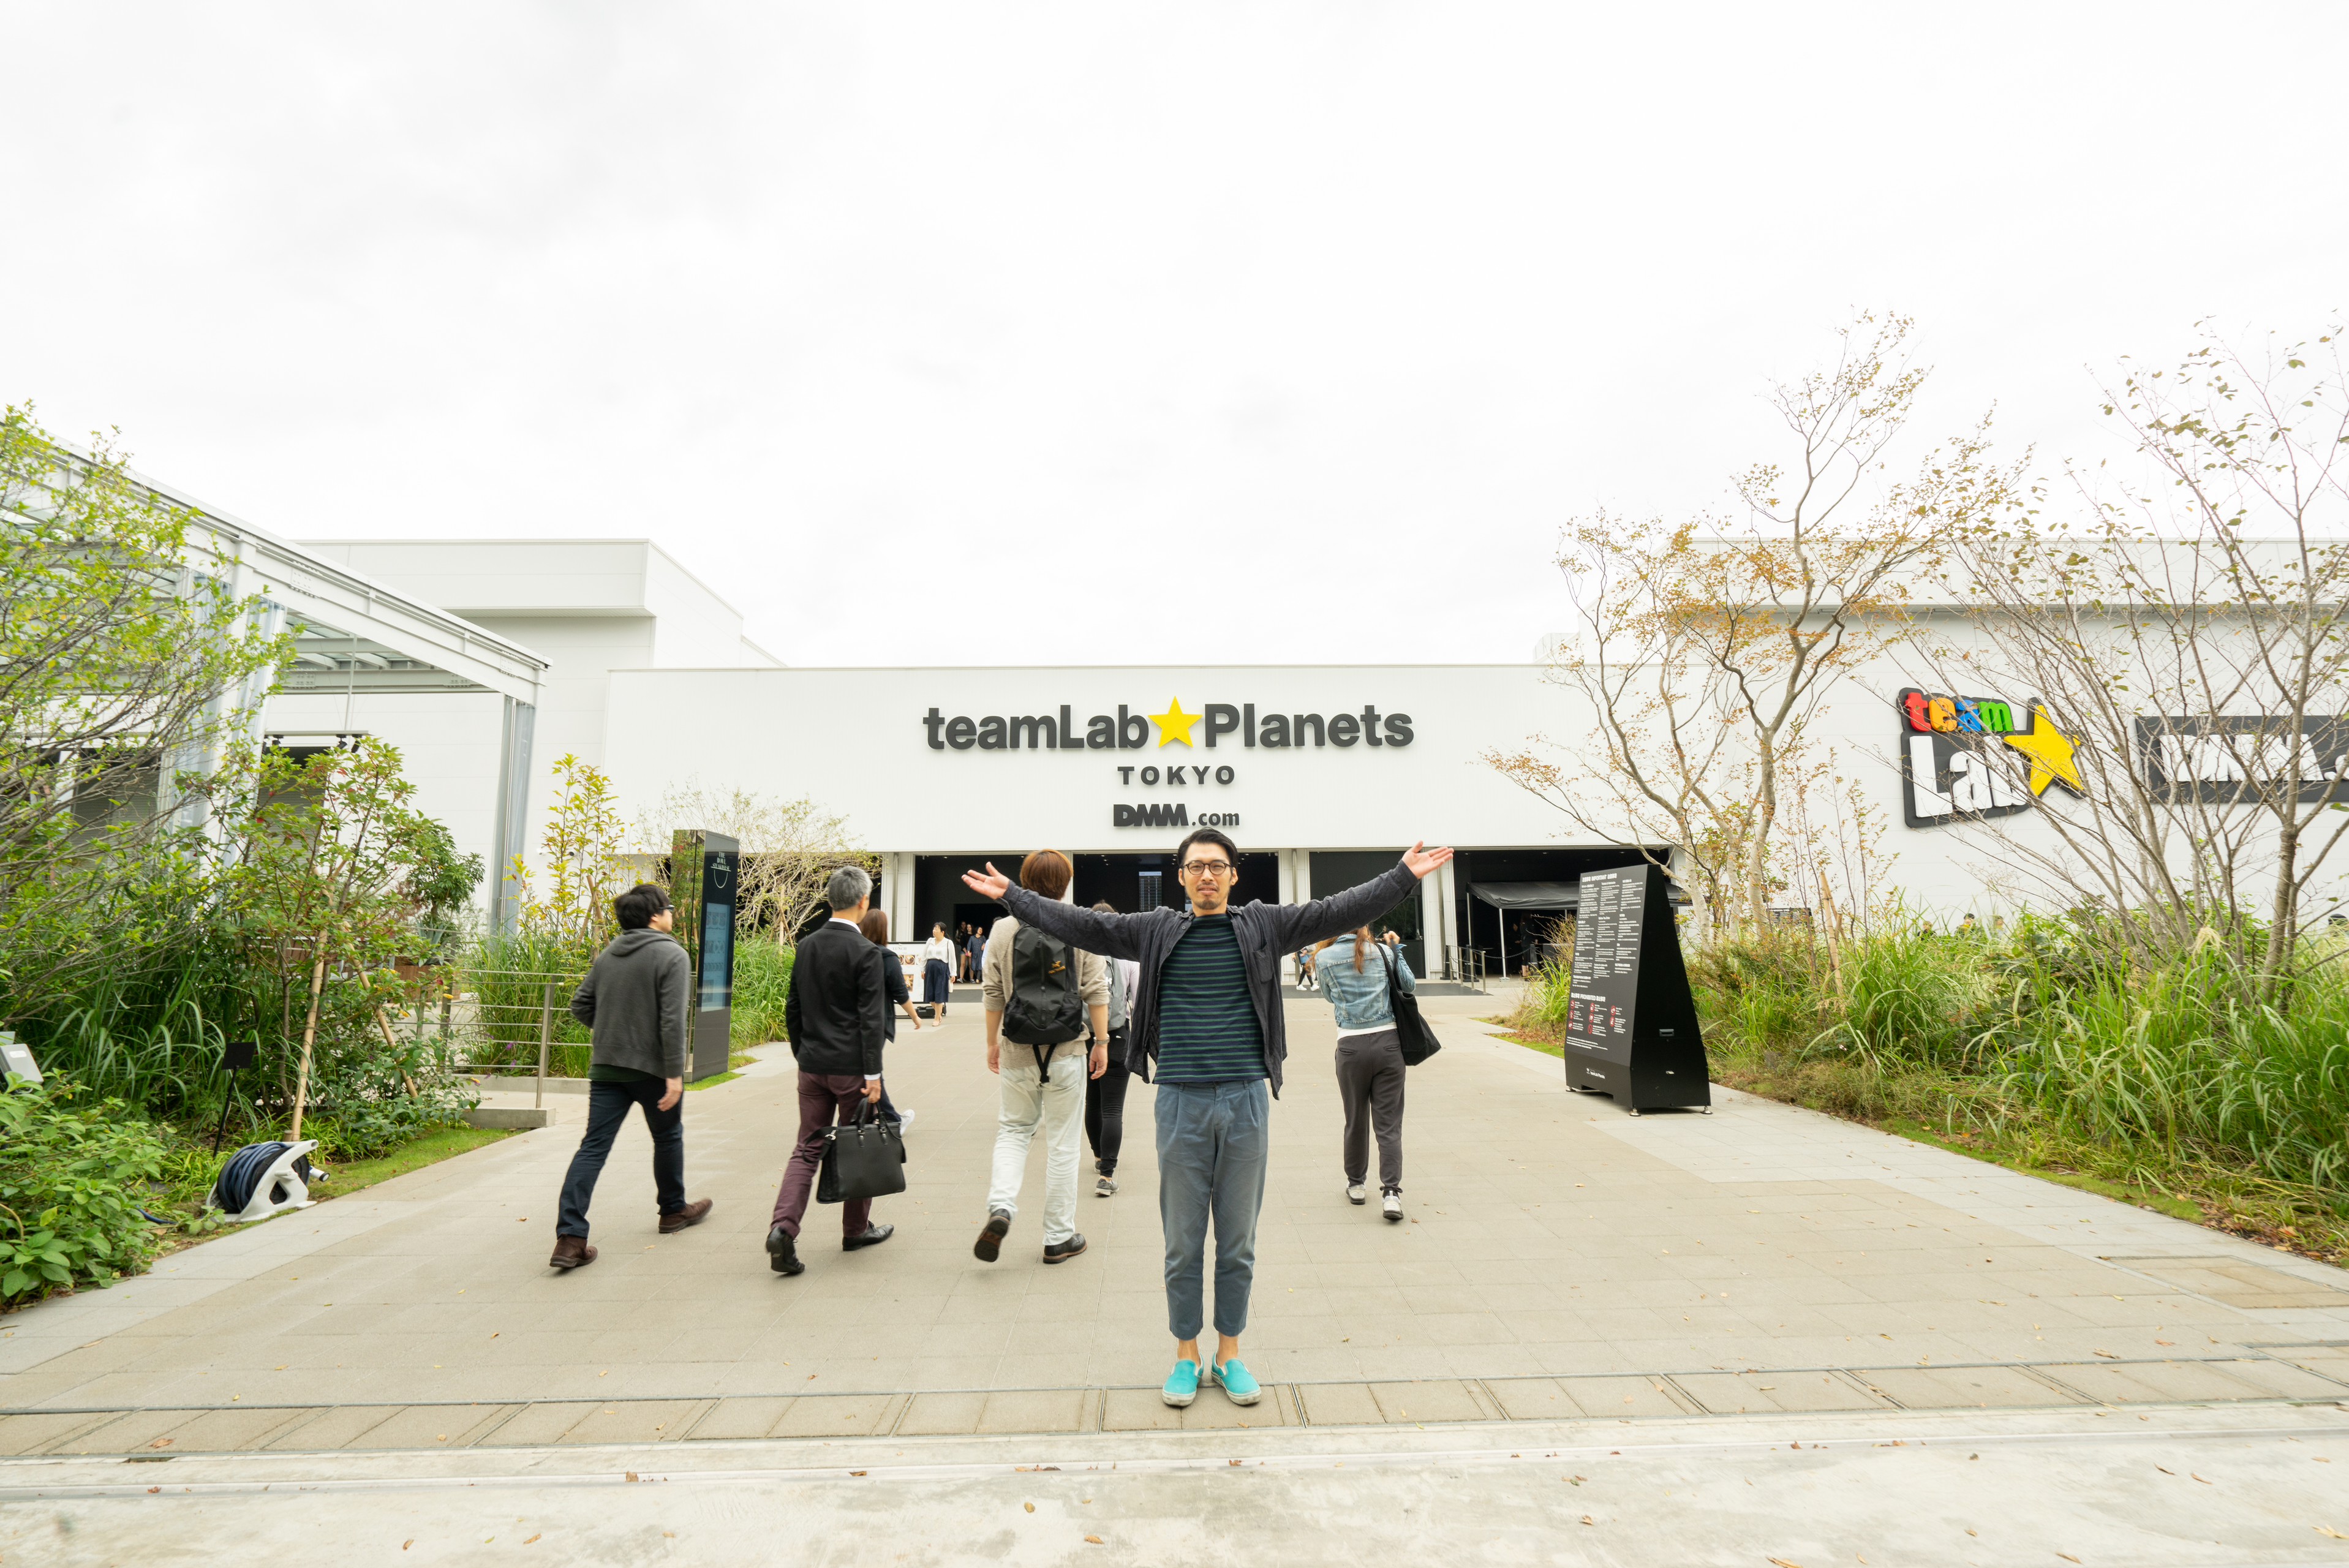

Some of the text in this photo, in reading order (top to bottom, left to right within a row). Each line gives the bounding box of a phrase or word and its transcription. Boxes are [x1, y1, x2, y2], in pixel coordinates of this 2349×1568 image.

[923, 703, 1414, 750] teamLab Planets
[1905, 692, 2013, 732] team
[1117, 766, 1235, 785] TOKYO
[1909, 736, 2028, 818] Lab
[1114, 804, 1239, 827] DMM.com
